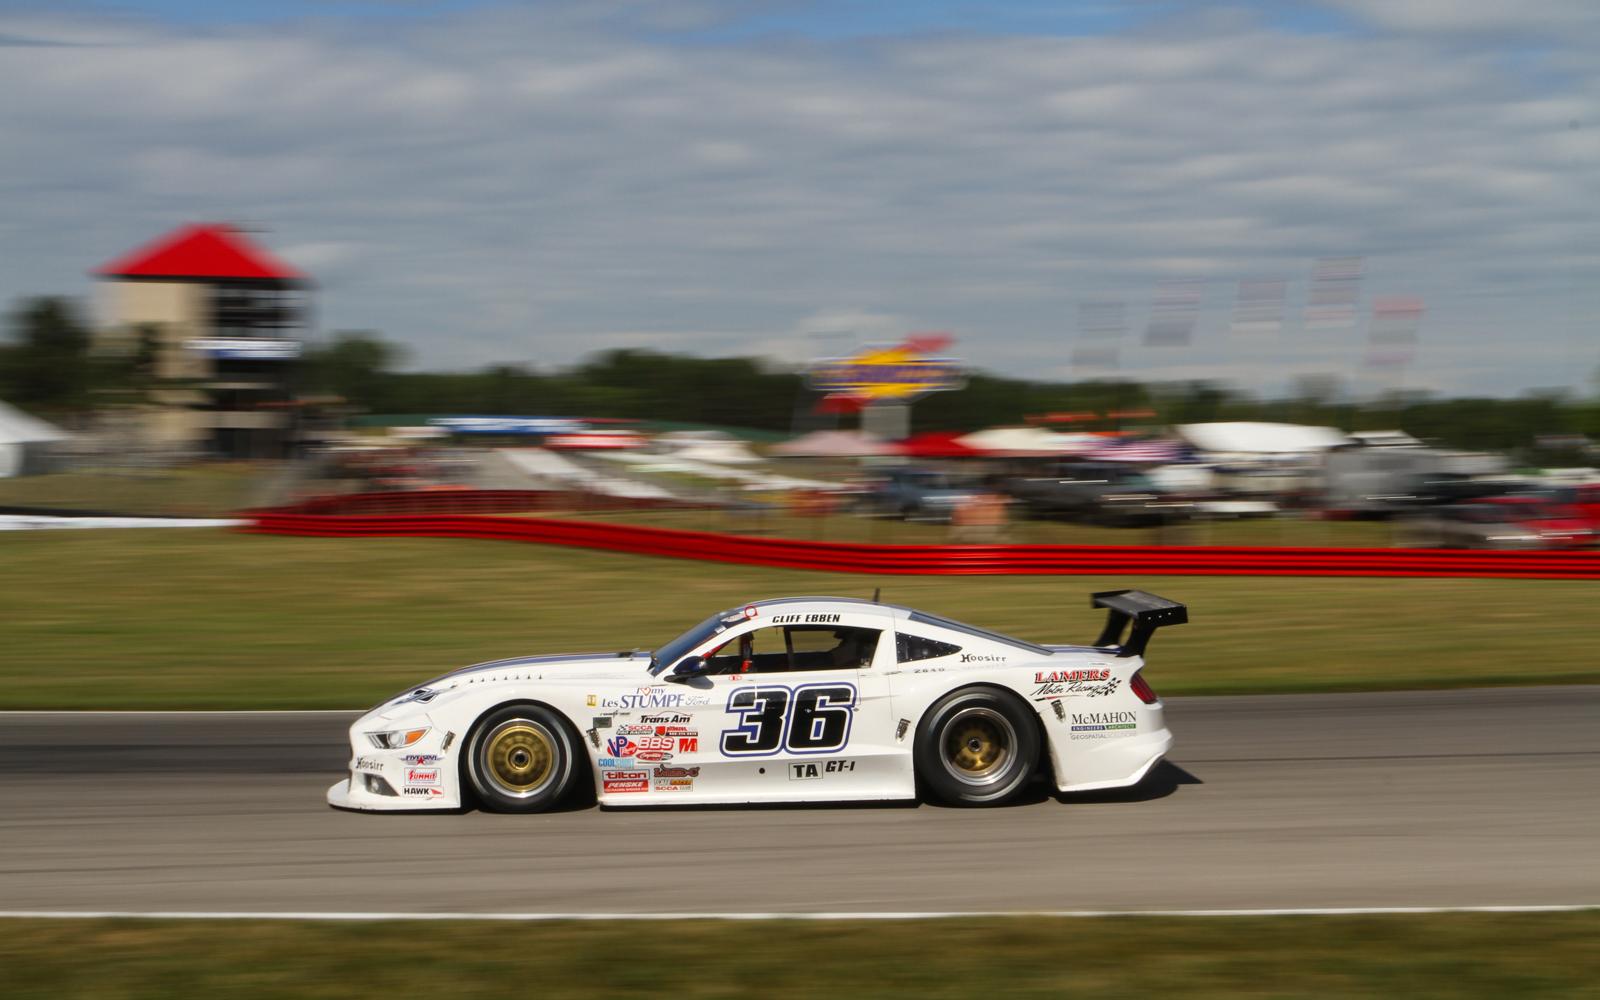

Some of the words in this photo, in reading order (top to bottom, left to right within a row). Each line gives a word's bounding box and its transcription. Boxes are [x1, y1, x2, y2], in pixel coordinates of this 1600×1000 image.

[772, 614, 802, 624] CLIFF
[805, 614, 841, 623] EBBEN
[960, 653, 1007, 663] Hoosier
[1034, 668, 1111, 684] LAMERS
[1031, 684, 1064, 696] Motor
[602, 698, 618, 708] Les
[620, 694, 684, 709] STUMPF
[640, 715, 669, 723] Trans
[671, 715, 691, 723] Am
[719, 682, 857, 757] 36
[1072, 711, 1137, 725] McMAHON
[607, 736, 628, 757] VP
[638, 737, 674, 750] BBS
[606, 771, 647, 779] tilton
[793, 764, 818, 778] TA
[404, 787, 429, 795] HAWK
